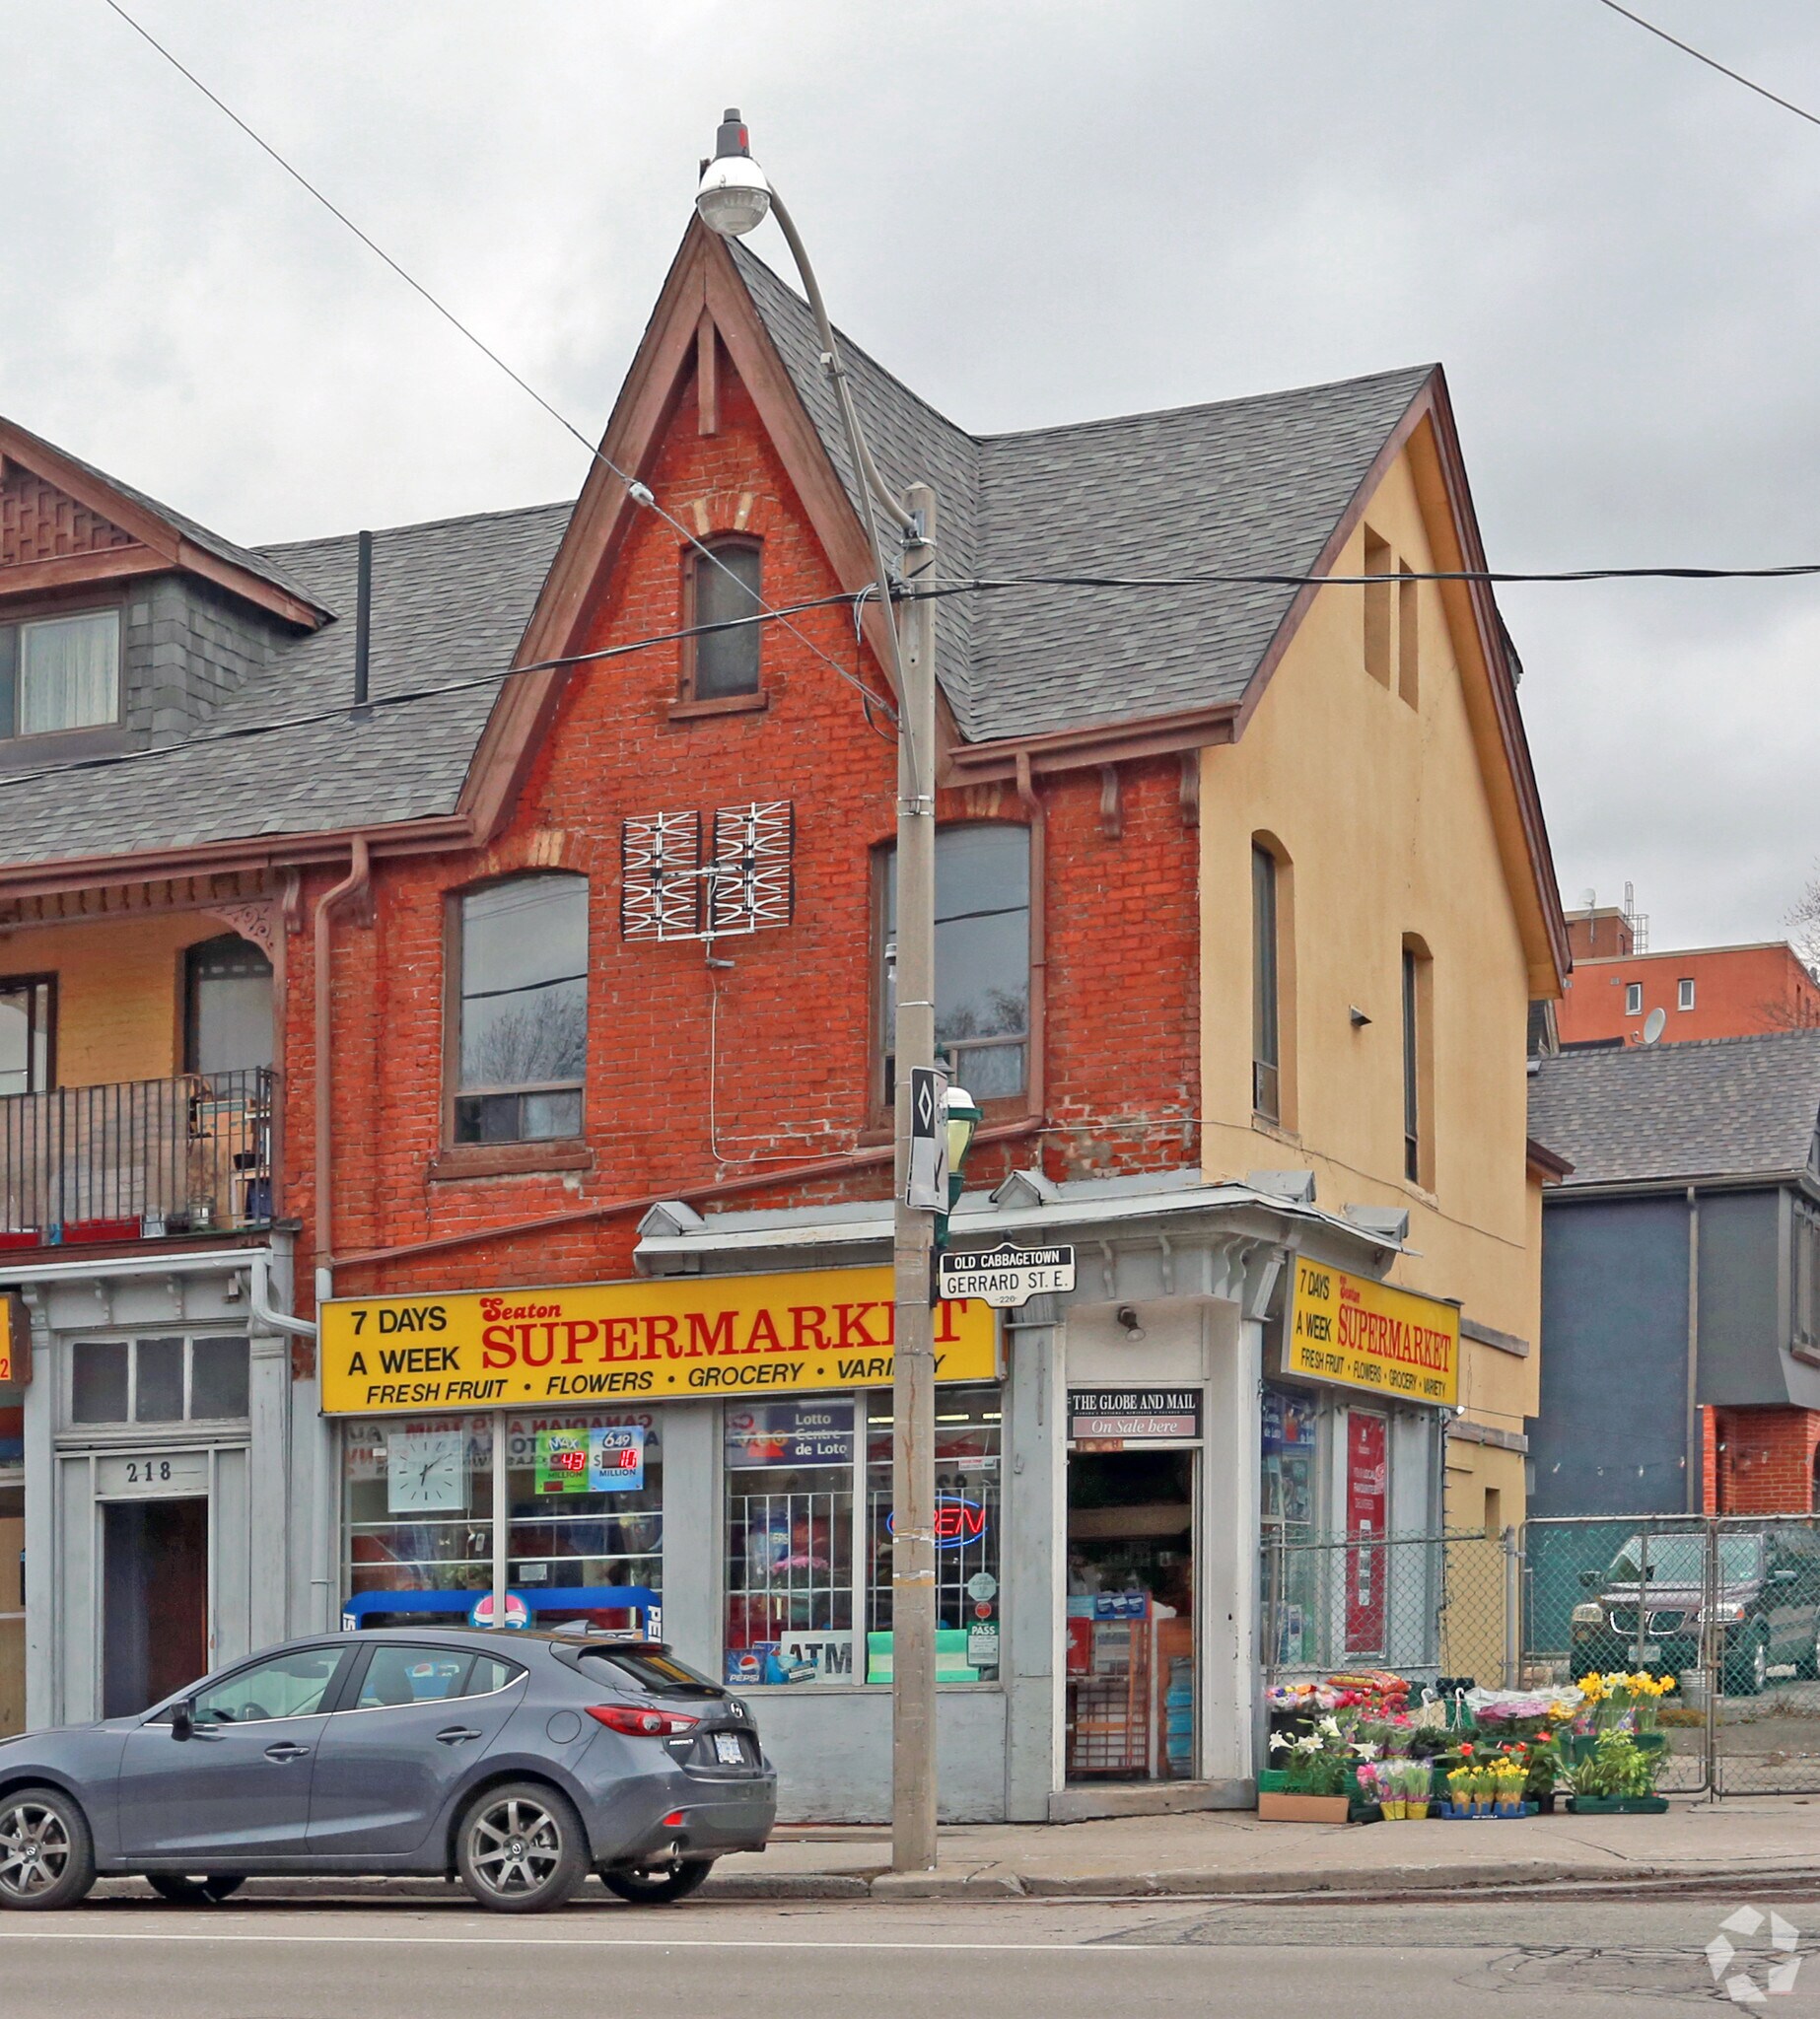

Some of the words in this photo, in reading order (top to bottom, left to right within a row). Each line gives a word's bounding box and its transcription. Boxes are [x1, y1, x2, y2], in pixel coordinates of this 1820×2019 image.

[953, 1256, 976, 1270] OLD
[980, 1250, 1060, 1269] CABBAGETOWN
[946, 1274, 1019, 1294] GERRARD
[1028, 1272, 1049, 1288] ST.
[1054, 1271, 1069, 1288] E.
[1300, 1269, 1307, 1293] 7
[1308, 1271, 1330, 1300] DAYS
[350, 1310, 368, 1335] 7
[379, 1305, 448, 1334] DAYS
[479, 1297, 562, 1322] Seaton
[482, 1297, 967, 1370] SUPERMARKT
[1295, 1309, 1303, 1336] A
[1306, 1312, 1332, 1343] WEEK
[1337, 1303, 1452, 1373] SUPERMARKET
[347, 1351, 368, 1376] A
[380, 1346, 460, 1374] WEEK
[366, 1383, 441, 1405] FRESH
[446, 1379, 509, 1400] FRUIT
[546, 1370, 654, 1395] FLOWERS
[688, 1362, 805, 1387] GROCERY
[837, 1355, 945, 1379] VARIY
[1301, 1347, 1323, 1370] FRESH
[1325, 1354, 1345, 1374] FRUIT
[1354, 1360, 1381, 1383] FLOWERS
[1388, 1368, 1419, 1391] GROCERY
[1424, 1377, 1446, 1398] VARIETY
[1073, 1394, 1097, 1411] THE
[1099, 1394, 1138, 1411] GLOBE
[1140, 1394, 1164, 1410] AND
[1166, 1393, 1196, 1410] MAIL
[796, 1414, 831, 1426] Lotto
[1091, 1419, 1111, 1433] On
[1116, 1419, 1145, 1433] Sale
[796, 1427, 841, 1440] Centre
[619, 1449, 639, 1469] 10
[795, 1442, 812, 1455] de
[817, 1442, 848, 1455] Loto
[561, 1450, 587, 1471] 43
[126, 1461, 172, 1483] 218
[598, 1468, 636, 1477] MILLION
[971, 1626, 996, 1636] PASS
[790, 1642, 852, 1674] ATM
